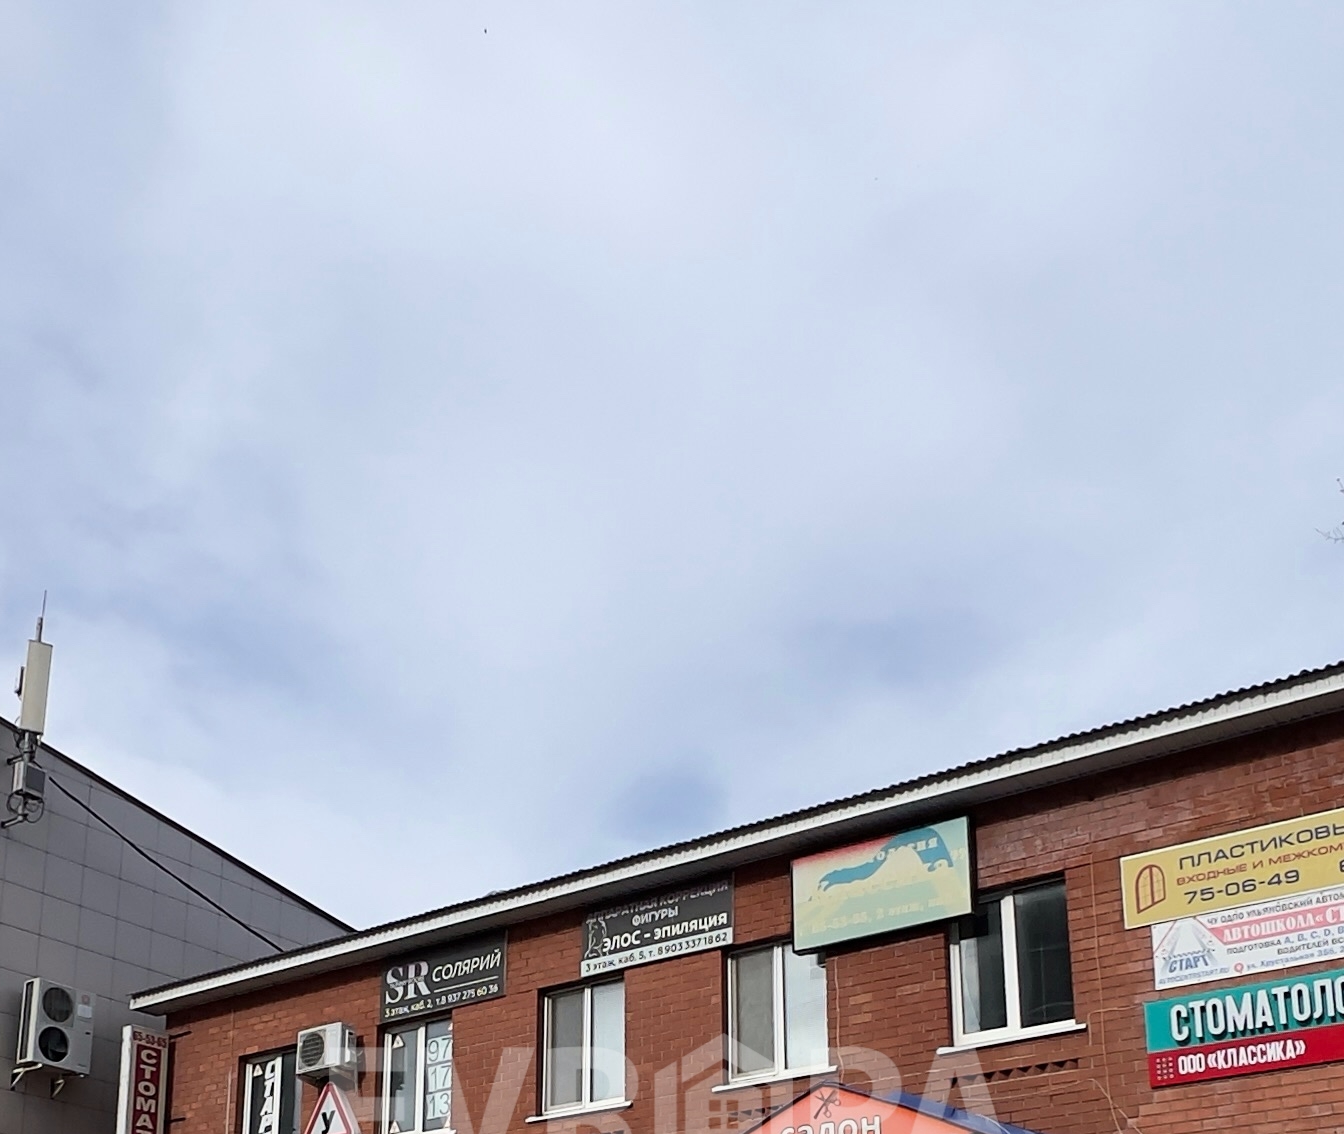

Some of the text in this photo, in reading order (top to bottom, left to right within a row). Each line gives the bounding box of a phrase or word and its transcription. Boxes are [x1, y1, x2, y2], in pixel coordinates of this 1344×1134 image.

[1176, 862, 1247, 886] ВХОДНЫЕ
[1252, 859, 1264, 870] И
[1183, 869, 1300, 905] 75-06-49
[632, 906, 679, 926] ФИГУРЫ
[1223, 912, 1315, 943] АВТОШКОЛА
[602, 930, 642, 952] ЭЛОС
[1277, 938, 1329, 955] ВОДИТЕЛЕЙ
[432, 948, 502, 982] СОЛЯРИЙ
[585, 963, 591, 973] 3
[1168, 955, 1209, 973] СТАРТ
[1177, 1037, 1306, 1075] ООО «КЛАССИКА»
